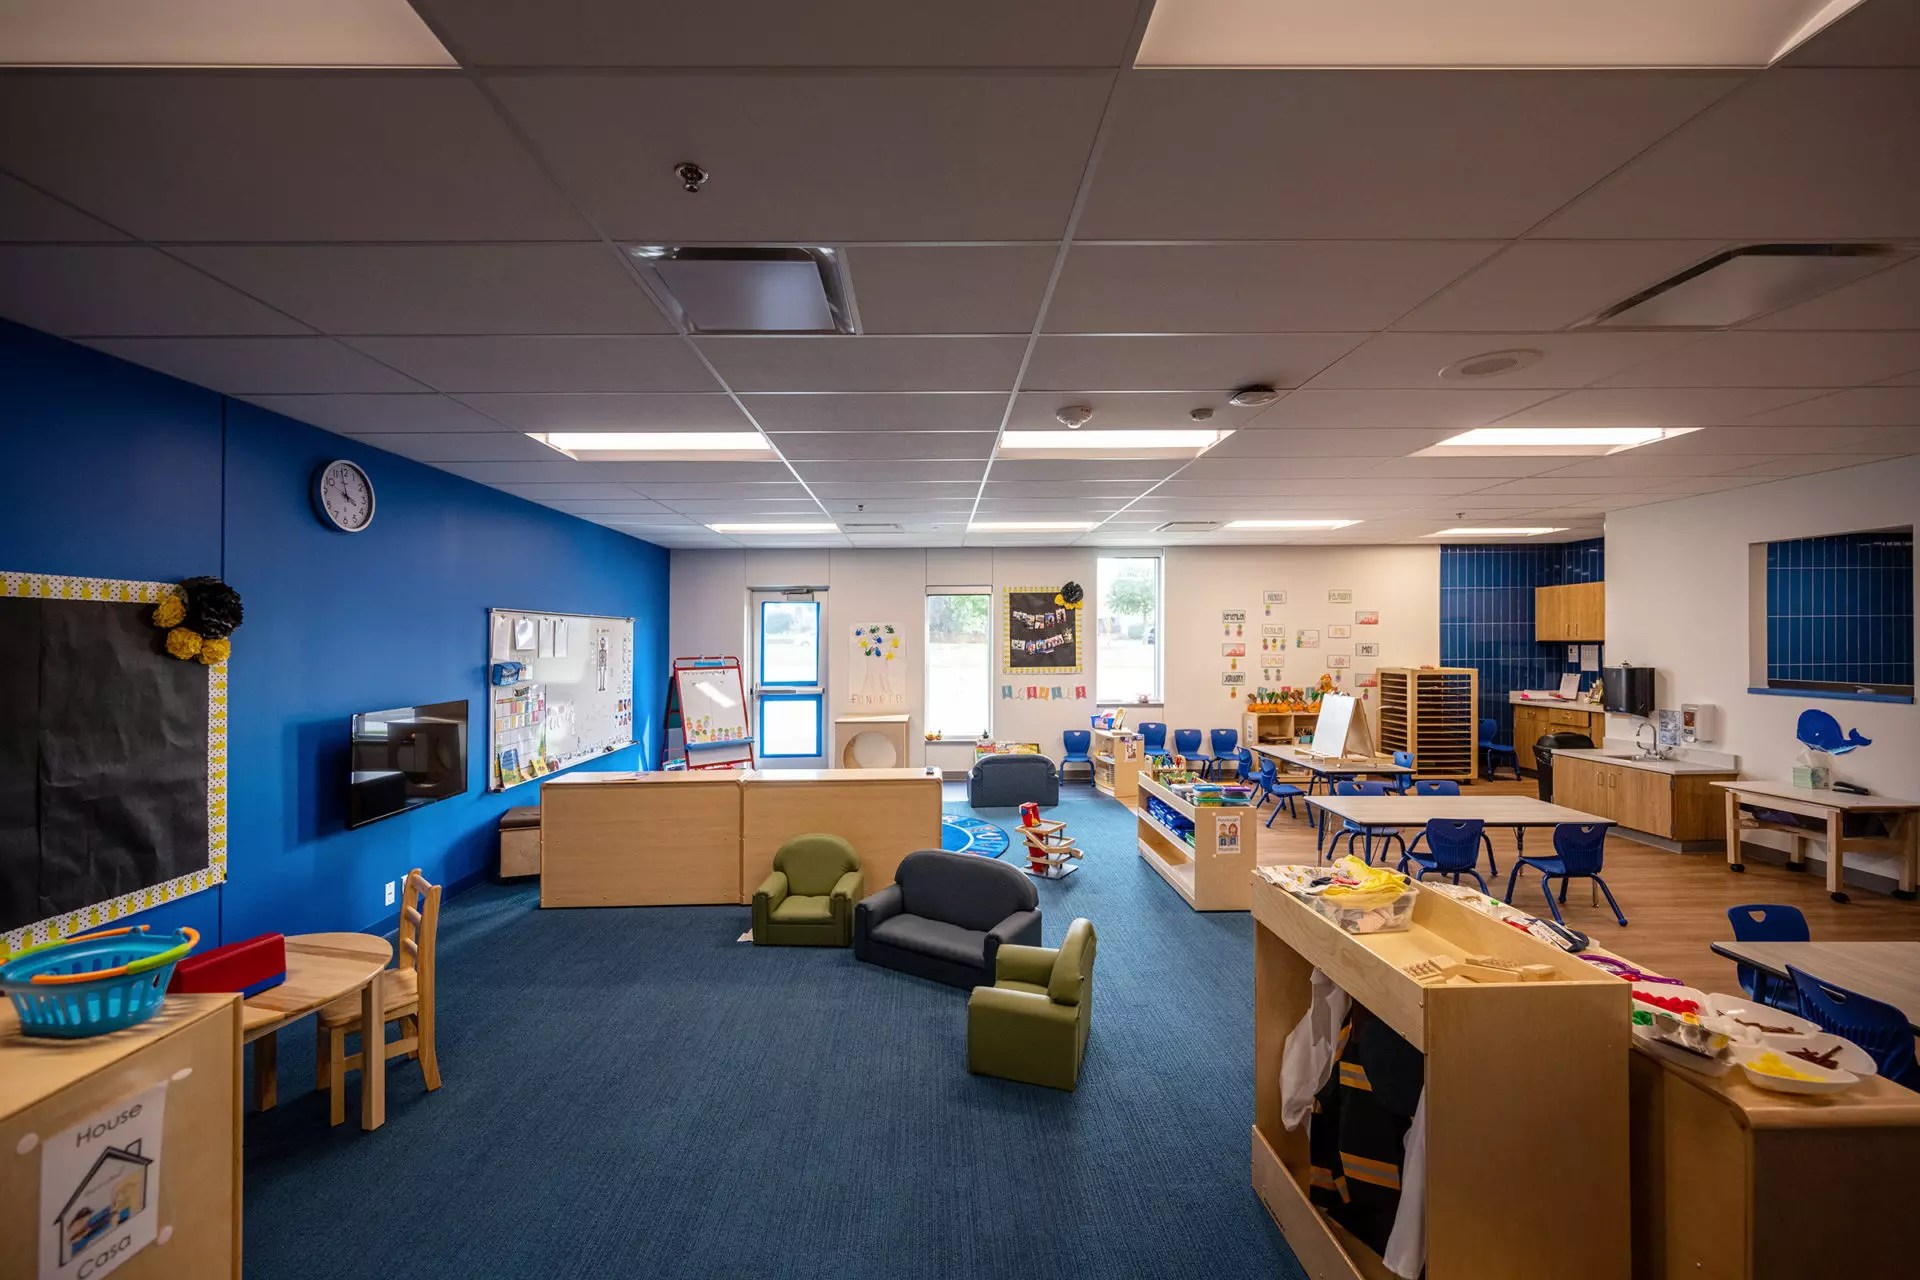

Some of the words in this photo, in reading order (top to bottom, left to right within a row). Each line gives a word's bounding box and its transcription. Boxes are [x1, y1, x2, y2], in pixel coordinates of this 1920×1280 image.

[326, 476, 335, 486] 10
[76, 1104, 143, 1148] House
[77, 1234, 132, 1280] Casa
